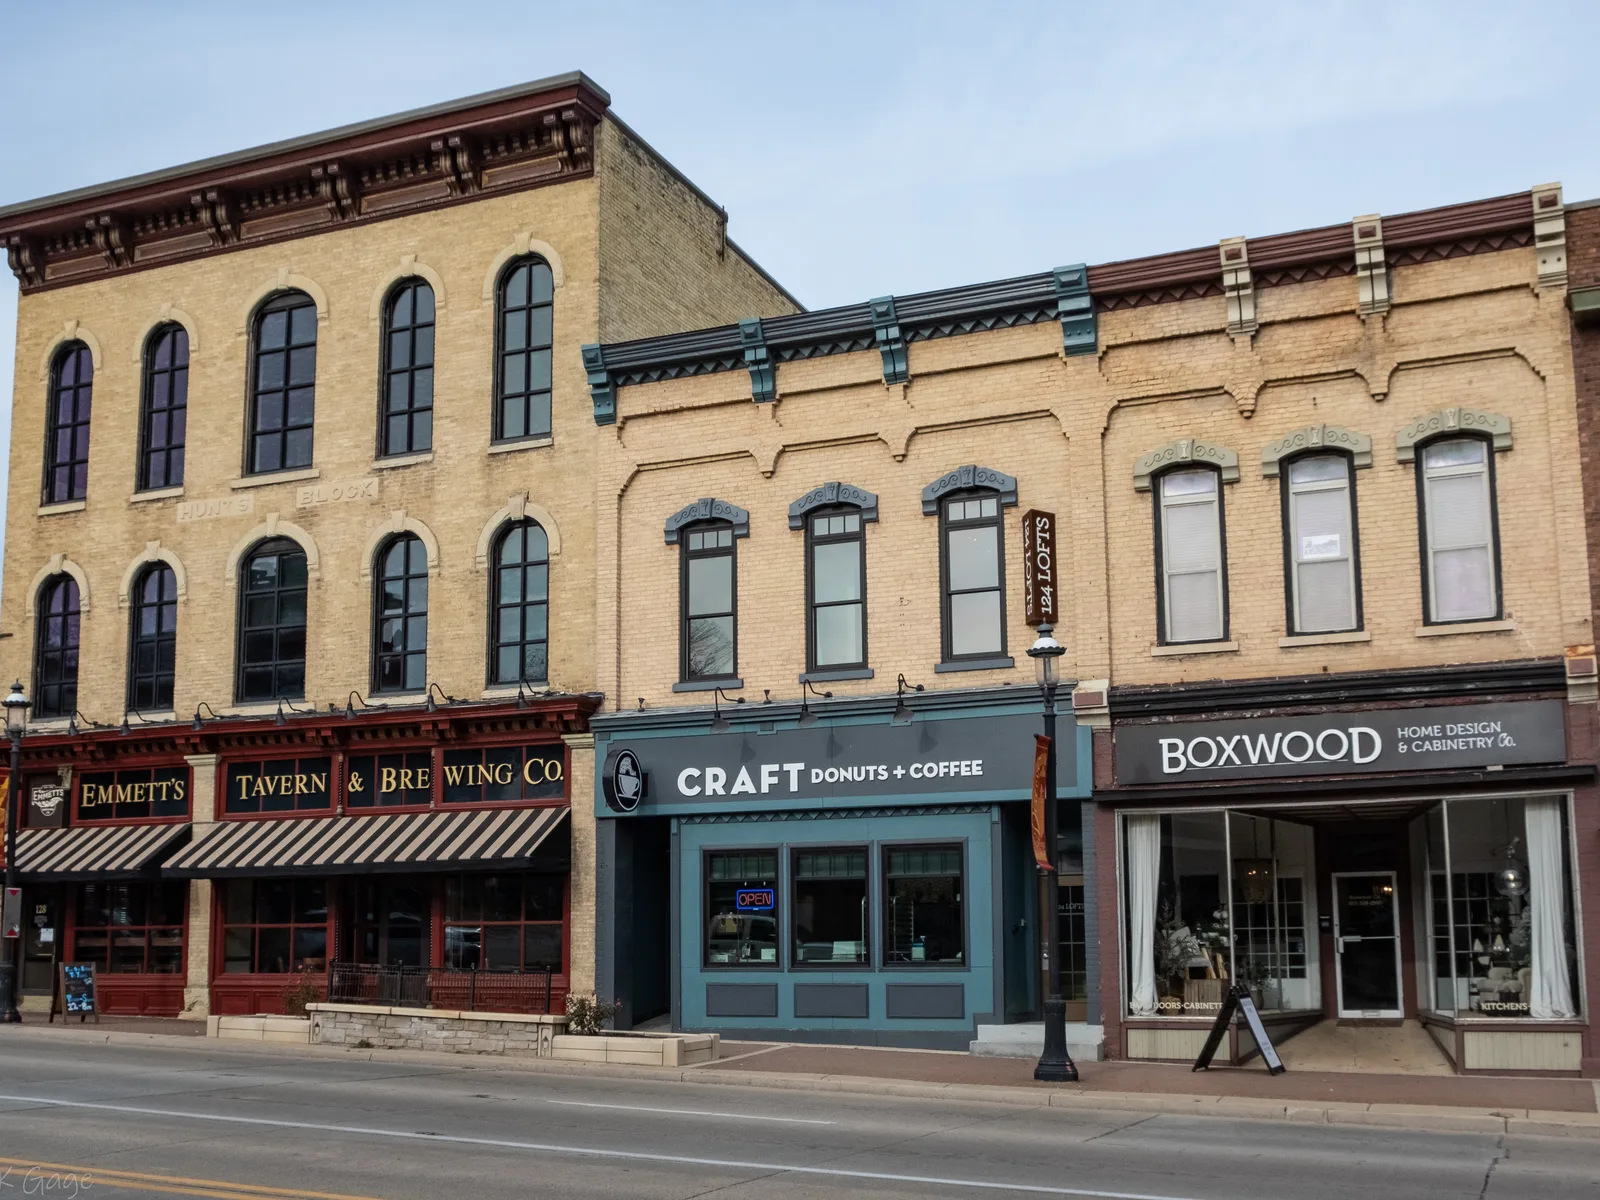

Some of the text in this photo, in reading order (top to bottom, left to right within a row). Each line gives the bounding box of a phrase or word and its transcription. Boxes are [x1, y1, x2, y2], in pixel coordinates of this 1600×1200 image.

[300, 480, 374, 506] BLOCK
[1036, 517, 1053, 614] 124 LOFTS
[1397, 721, 1502, 738] HOME DESIGN
[1159, 727, 1382, 774] BOXWOOD
[1398, 741, 1408, 753] &
[1411, 737, 1494, 752] CABINETRY
[81, 778, 185, 807] EMMETT'S
[236, 773, 328, 800] TAVERN
[348, 771, 364, 793] &
[677, 762, 805, 797] CRAFT
[811, 764, 889, 784] DONUTS
[909, 759, 983, 779] COFFEE
[739, 893, 772, 905] OPEN
